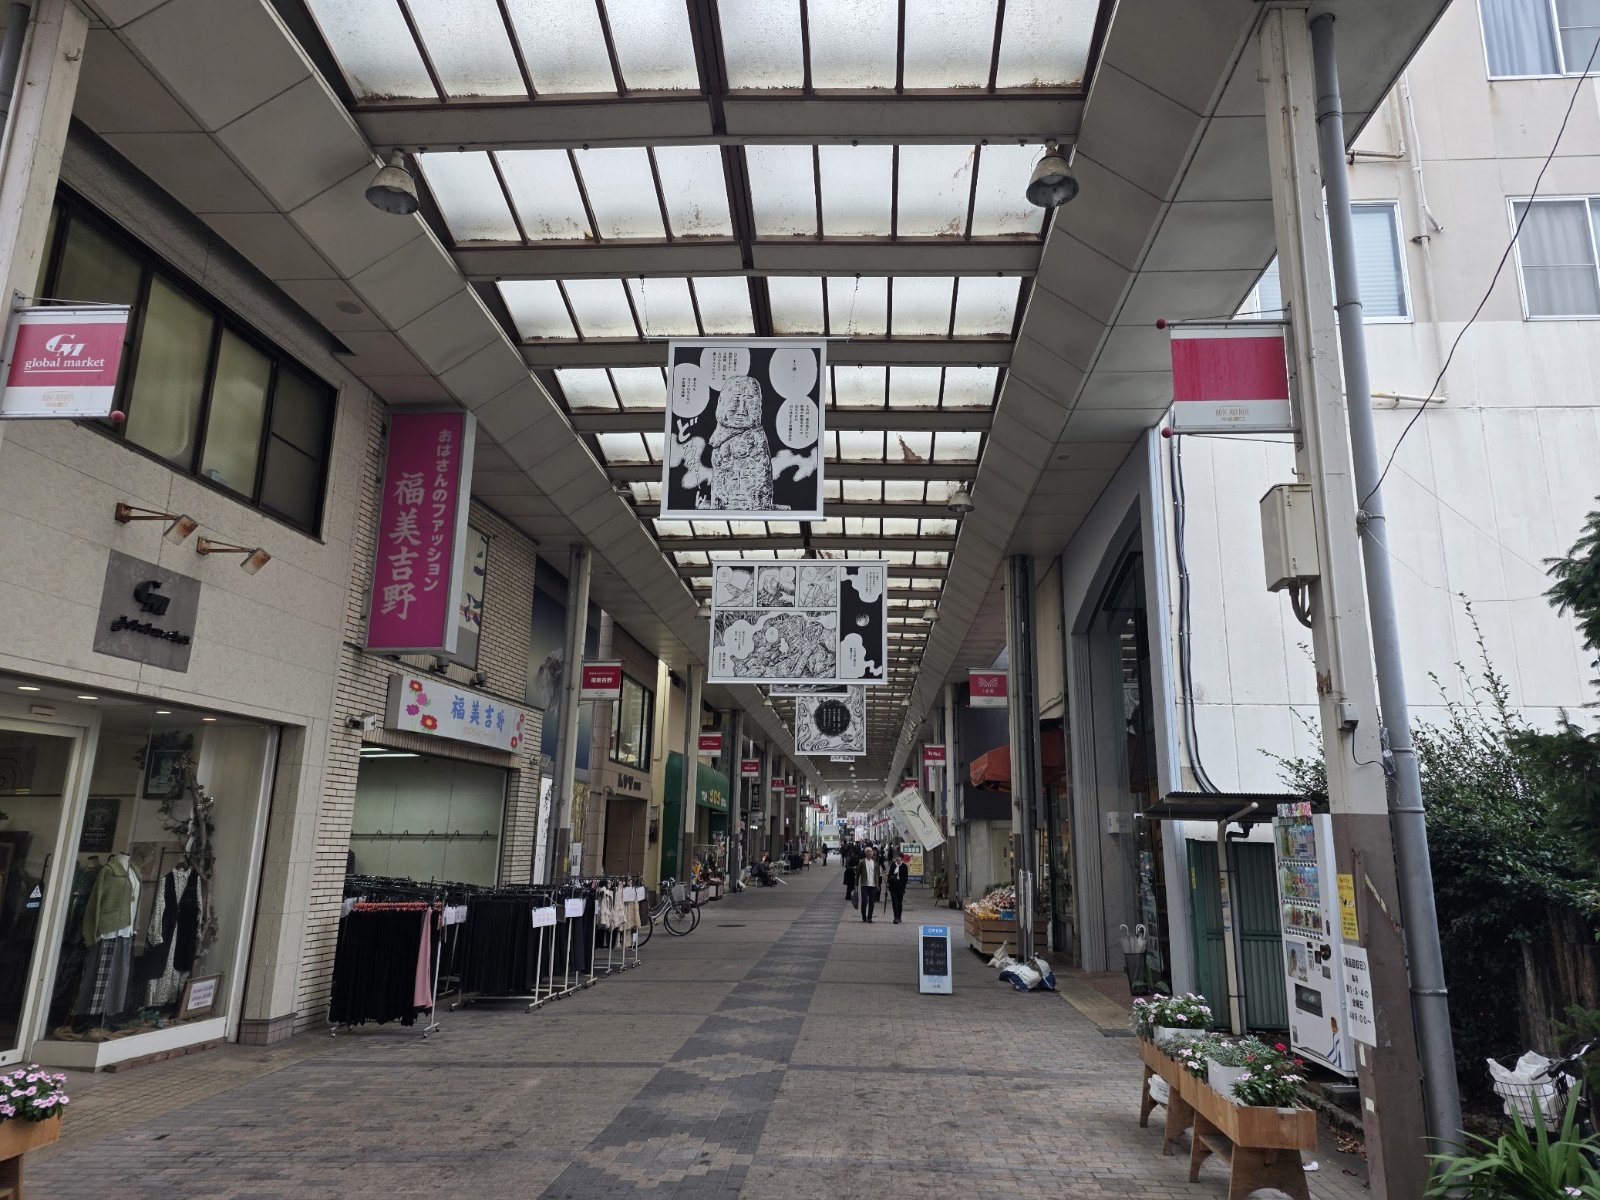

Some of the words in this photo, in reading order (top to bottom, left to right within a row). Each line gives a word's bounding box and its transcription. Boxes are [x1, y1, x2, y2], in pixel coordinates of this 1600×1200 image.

[24, 357, 60, 370] global
[63, 357, 105, 367] market
[380, 471, 426, 621] 福美吉野
[450, 694, 506, 733] 福美吉野
